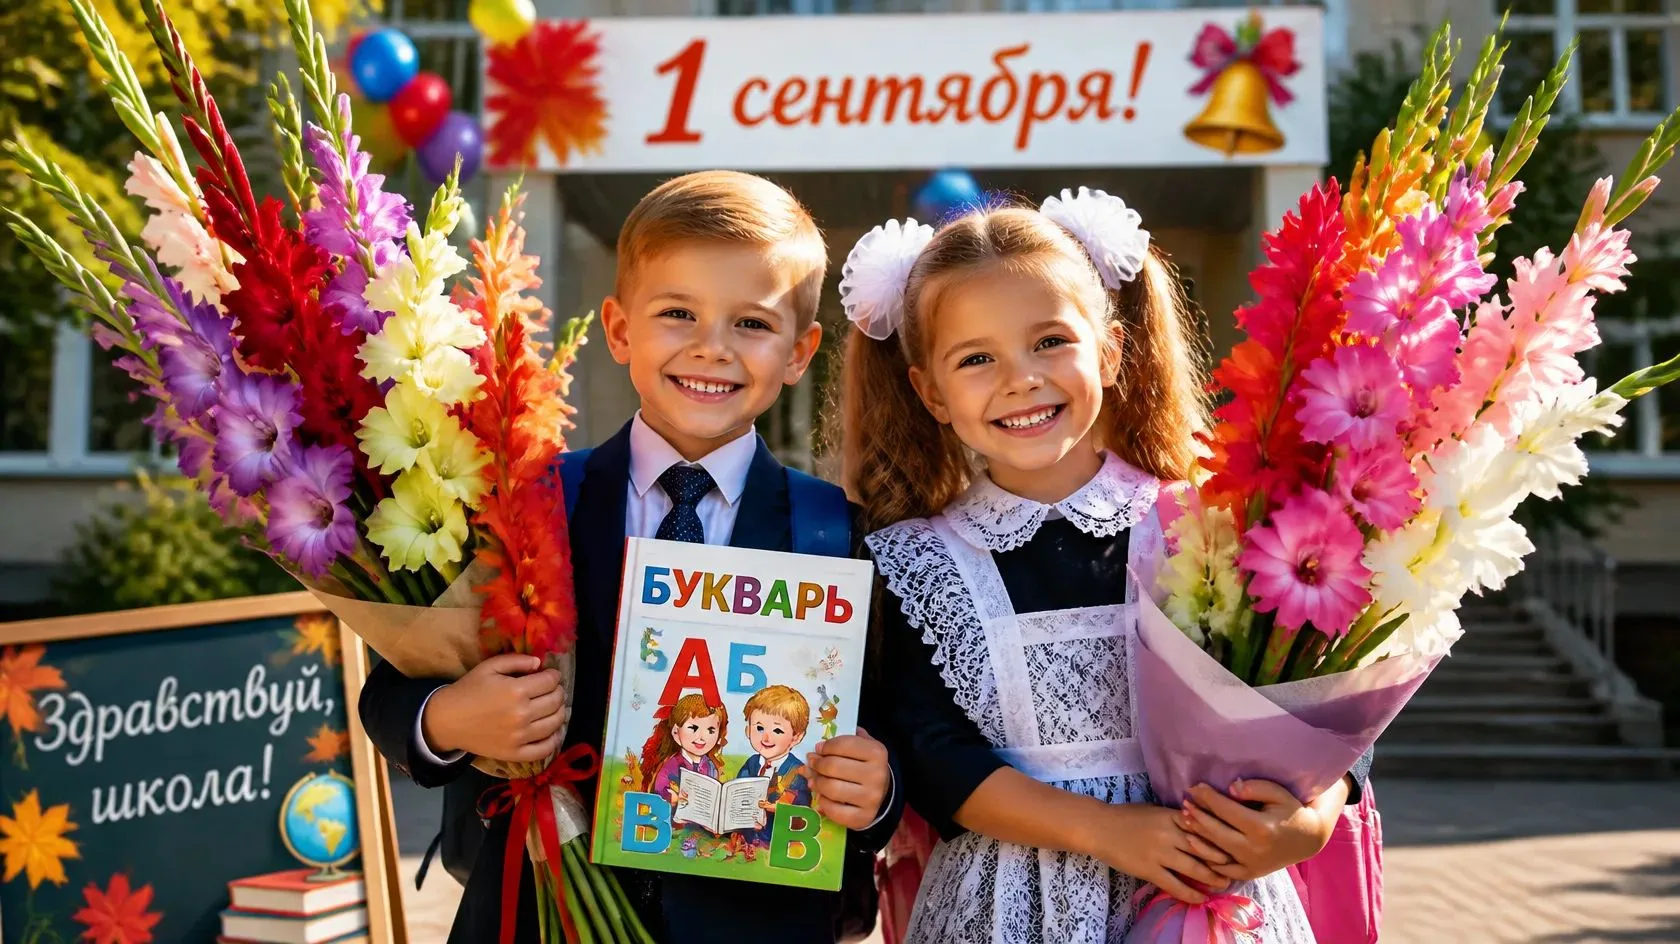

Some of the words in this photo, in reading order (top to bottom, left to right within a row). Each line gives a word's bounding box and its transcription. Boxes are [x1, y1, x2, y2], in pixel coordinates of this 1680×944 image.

[645, 39, 707, 145] 1
[732, 43, 1152, 150] сентября!
[641, 565, 853, 624] БУКВАРЬ
[34, 663, 335, 766] Здравствуй,
[91, 743, 274, 824] школа!
[621, 791, 673, 854] В
[769, 803, 822, 872] В
